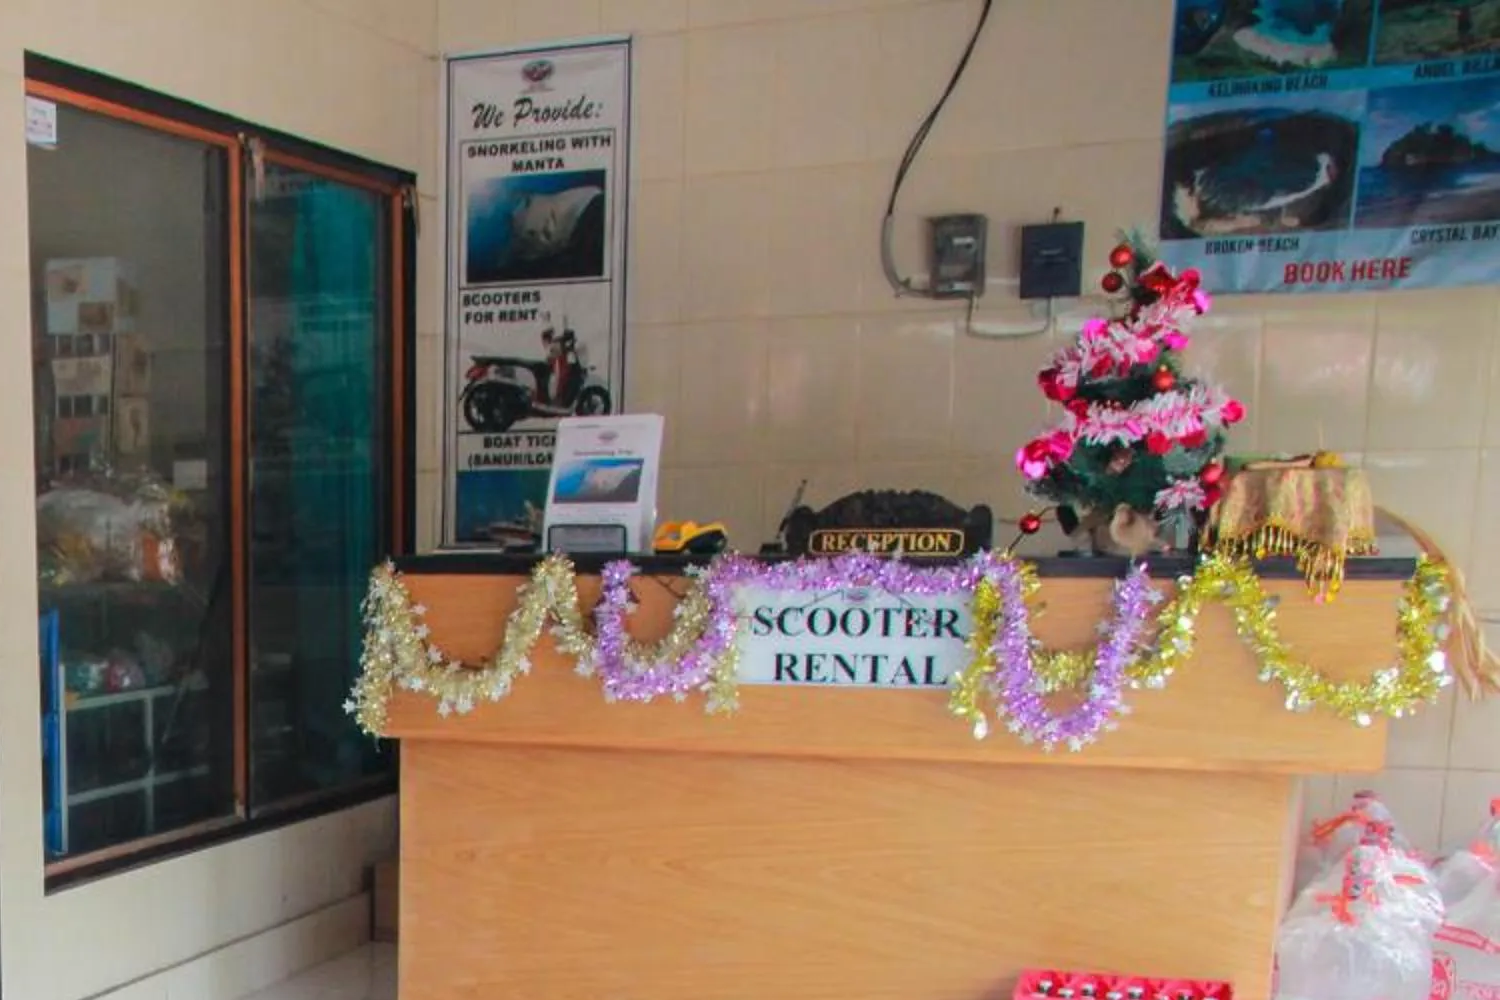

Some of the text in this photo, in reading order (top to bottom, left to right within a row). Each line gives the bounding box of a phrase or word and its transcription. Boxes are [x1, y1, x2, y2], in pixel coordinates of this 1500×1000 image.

[472, 102, 504, 129] We
[467, 135, 611, 159] SNORKELING WITH
[511, 157, 565, 173] MANTA
[1411, 227, 1468, 244] CRYSTAL
[1258, 236, 1299, 253] BEACH
[1284, 256, 1412, 284] BOOK HERE
[462, 291, 541, 307] SCOOTERS
[465, 308, 538, 325] FOR RENT
[483, 435, 521, 449] BOAT
[822, 533, 952, 551] RECEPTION
[753, 606, 965, 640] SCOOTER
[774, 652, 948, 685] RENTAL
